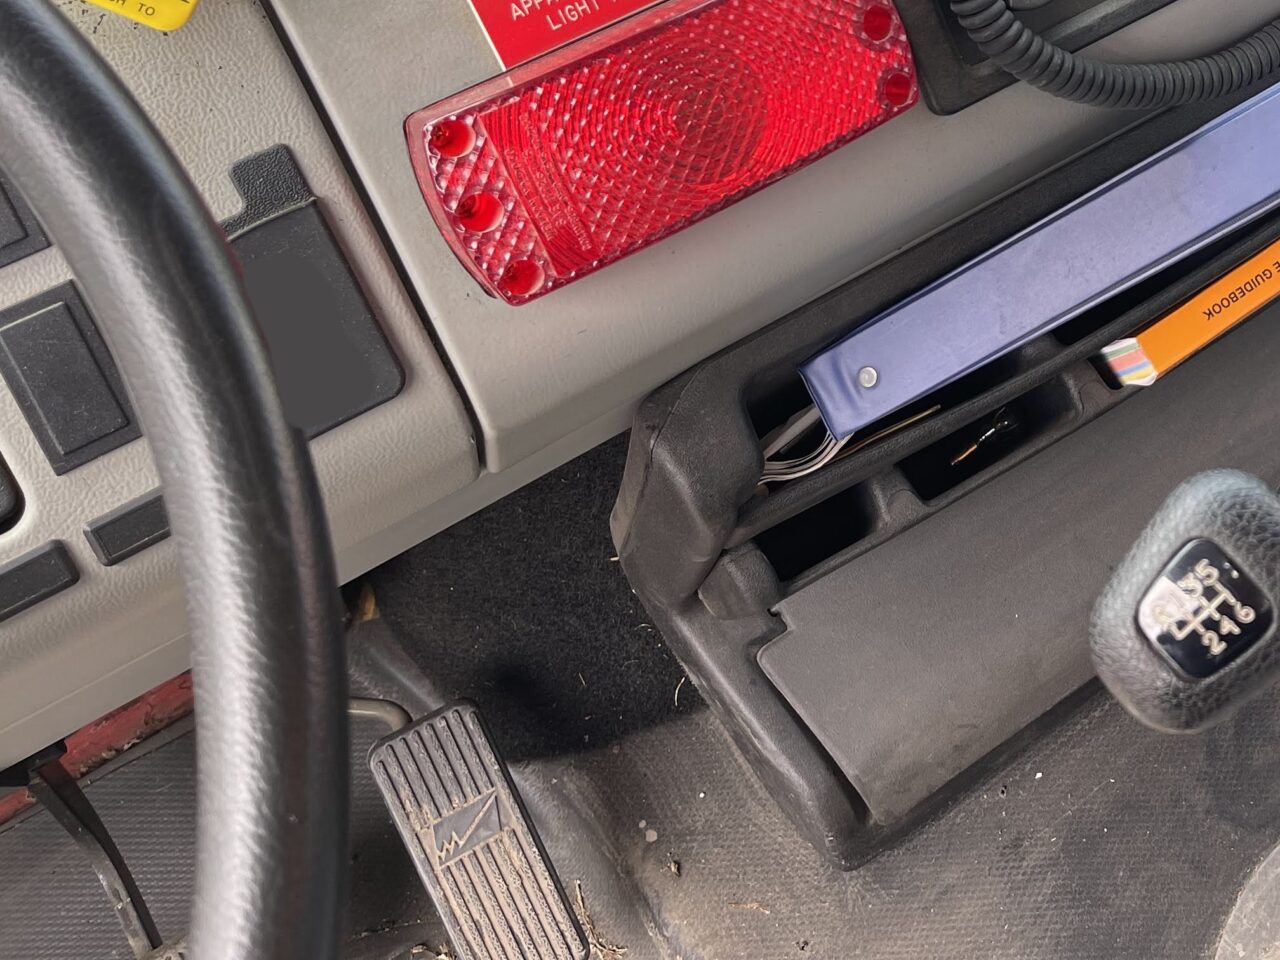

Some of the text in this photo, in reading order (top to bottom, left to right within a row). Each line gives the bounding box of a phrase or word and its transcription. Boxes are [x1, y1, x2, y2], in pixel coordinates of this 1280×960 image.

[138, 2, 156, 17] TO
[1201, 268, 1273, 322] GUIDEBOOK
[1194, 558, 1220, 587] 5
[1201, 600, 1257, 656] 2 4 6
